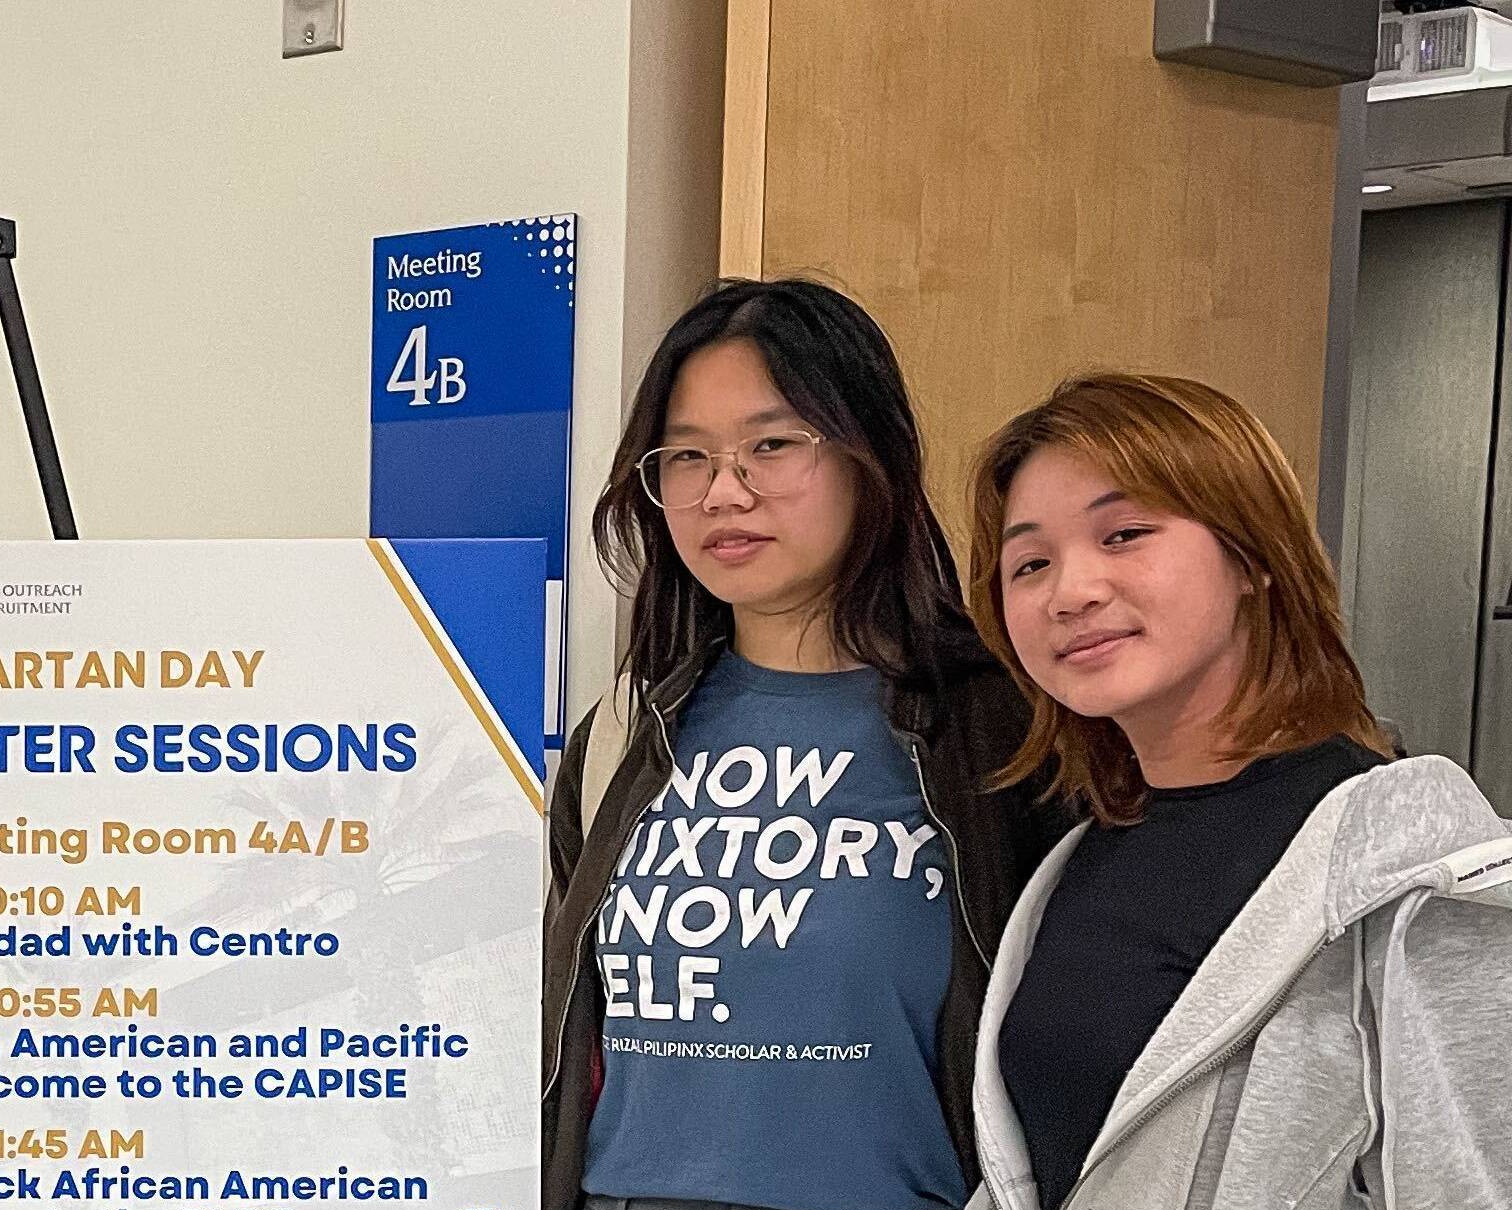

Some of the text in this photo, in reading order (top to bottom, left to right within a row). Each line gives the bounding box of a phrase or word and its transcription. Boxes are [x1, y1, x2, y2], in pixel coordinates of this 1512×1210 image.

[387, 249, 482, 279] Meeting
[387, 288, 452, 312] Room
[386, 325, 466, 406] 4B
[3, 584, 83, 597] OUTREACH
[161, 650, 265, 689] DAY
[114, 724, 417, 773] SESSIONS
[651, 745, 855, 812] NOW
[103, 821, 236, 854] Room
[248, 817, 369, 856] 4A/B
[76, 887, 141, 916] AM
[83, 923, 178, 956] with
[190, 926, 340, 957] Centro
[92, 989, 157, 1017] AM
[597, 954, 731, 1023] ELF.
[11, 1024, 217, 1058] American
[229, 1027, 307, 1058] and
[320, 1023, 469, 1058] Pacific
[611, 1038, 643, 1054] RIZAL
[644, 1040, 703, 1059] PILIPINX
[706, 1043, 781, 1060] SCHOLAR
[786, 1045, 797, 1060] &
[800, 1043, 872, 1060] ACTIVIST
[117, 1071, 162, 1099] to
[173, 1068, 244, 1099] the
[254, 1068, 407, 1099] CAPISE
[79, 1130, 144, 1159] AM
[51, 1166, 209, 1200] African
[220, 1166, 428, 1200] American
